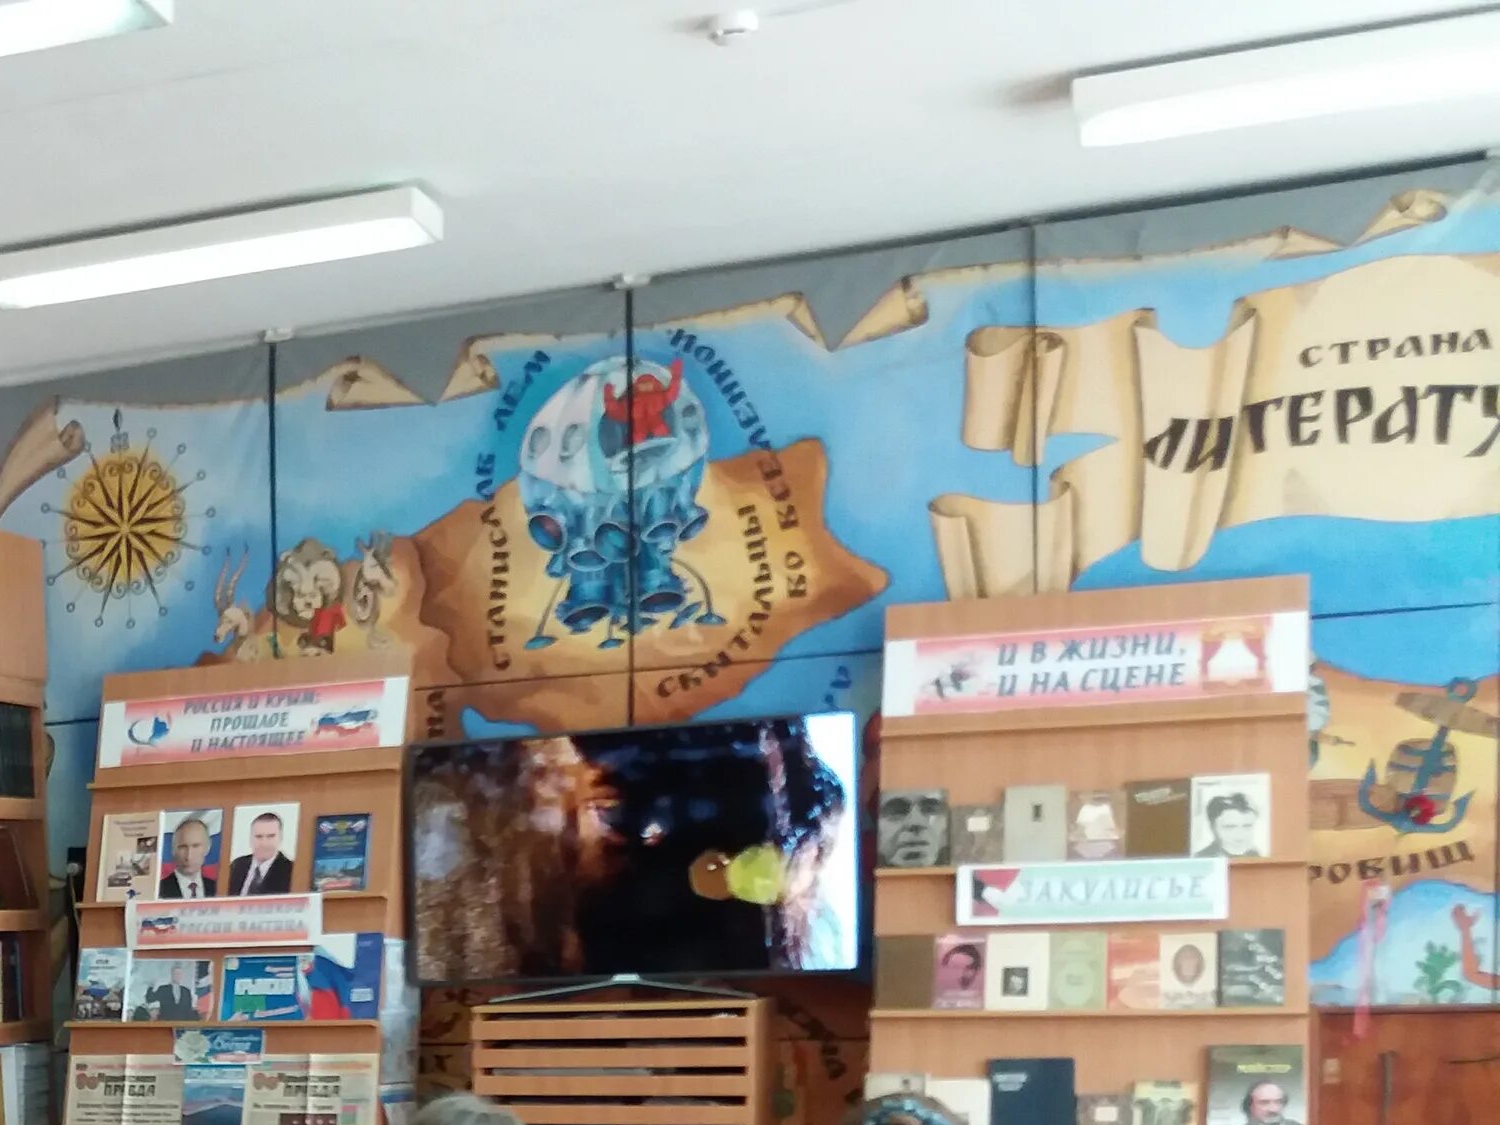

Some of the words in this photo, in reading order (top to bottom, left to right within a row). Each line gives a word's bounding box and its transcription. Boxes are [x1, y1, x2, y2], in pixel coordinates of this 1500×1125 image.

[1299, 328, 1490, 368] СТРАНА
[493, 349, 551, 432] ЛЕМ
[666, 328, 799, 532] ВСЕЛЕННОЙ
[784, 550, 808, 599] ВО
[656, 502, 774, 698] СКИТАЛЬЦЫ
[998, 642, 1018, 666] И
[1029, 641, 1047, 664] В
[1056, 632, 1187, 663] ЖИЗНИ,
[997, 674, 1018, 697] И
[1029, 670, 1069, 694] НА
[1079, 662, 1186, 693] СЦЕНЕ
[183, 696, 243, 714] РОССИЯ
[210, 712, 289, 733] ПРОШЛОЕ
[191, 738, 202, 752] И
[207, 730, 306, 751] НАСТОЯЩЕЕ
[1017, 875, 1208, 905] ЗАКУЛИСЬЕ
[180, 921, 232, 933] РОССИИ
